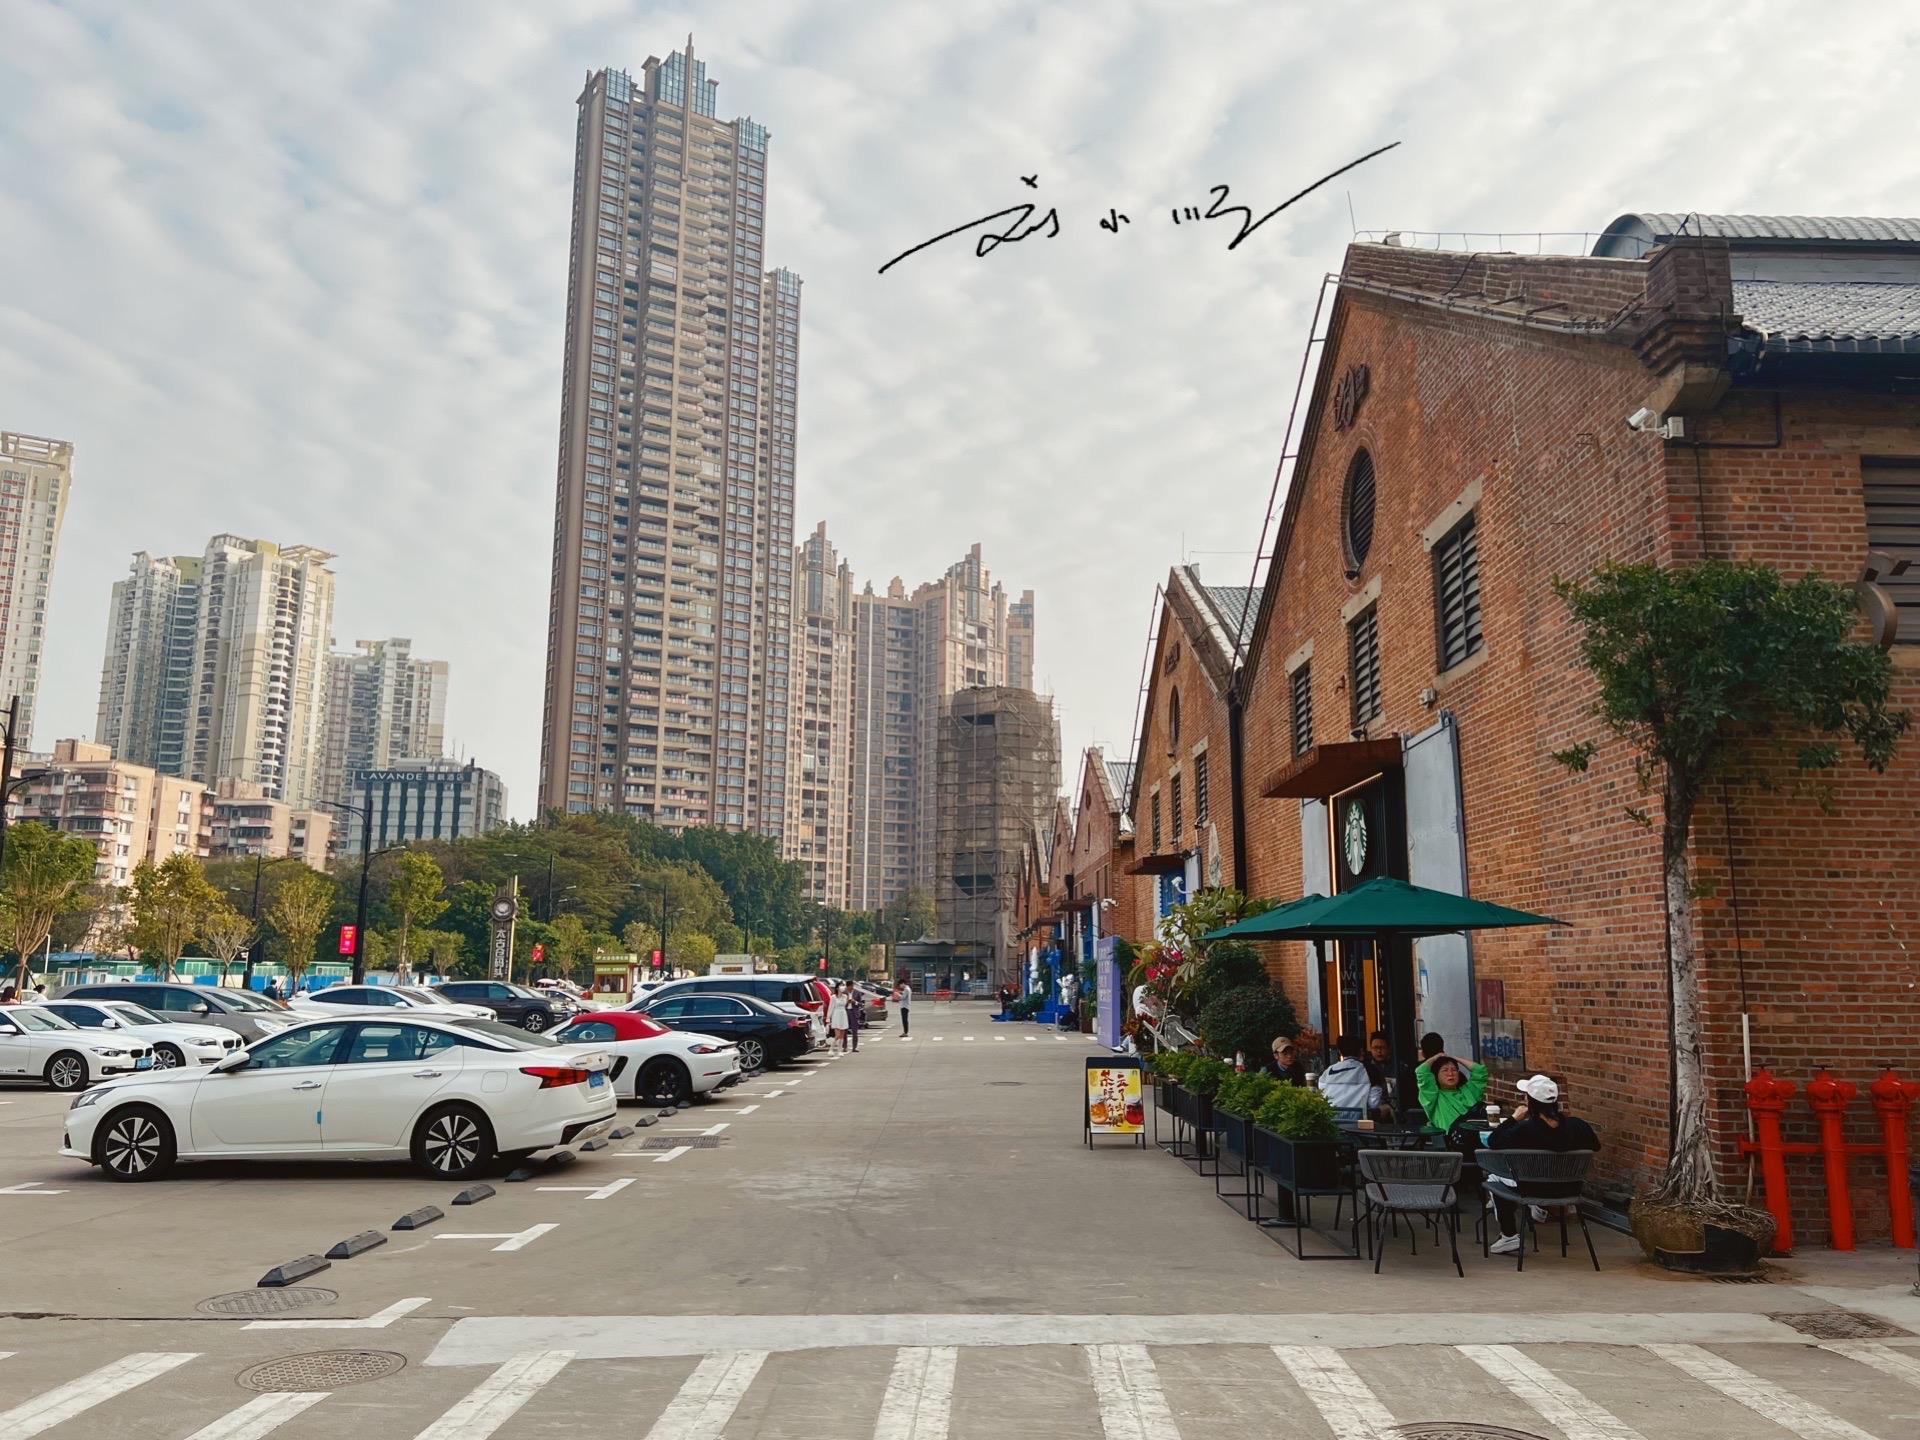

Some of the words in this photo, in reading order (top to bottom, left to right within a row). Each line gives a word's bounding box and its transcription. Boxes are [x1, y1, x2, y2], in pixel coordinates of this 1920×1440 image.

[360, 772, 422, 780] LAVANDE
[493, 928, 507, 978] 太古仓码头
